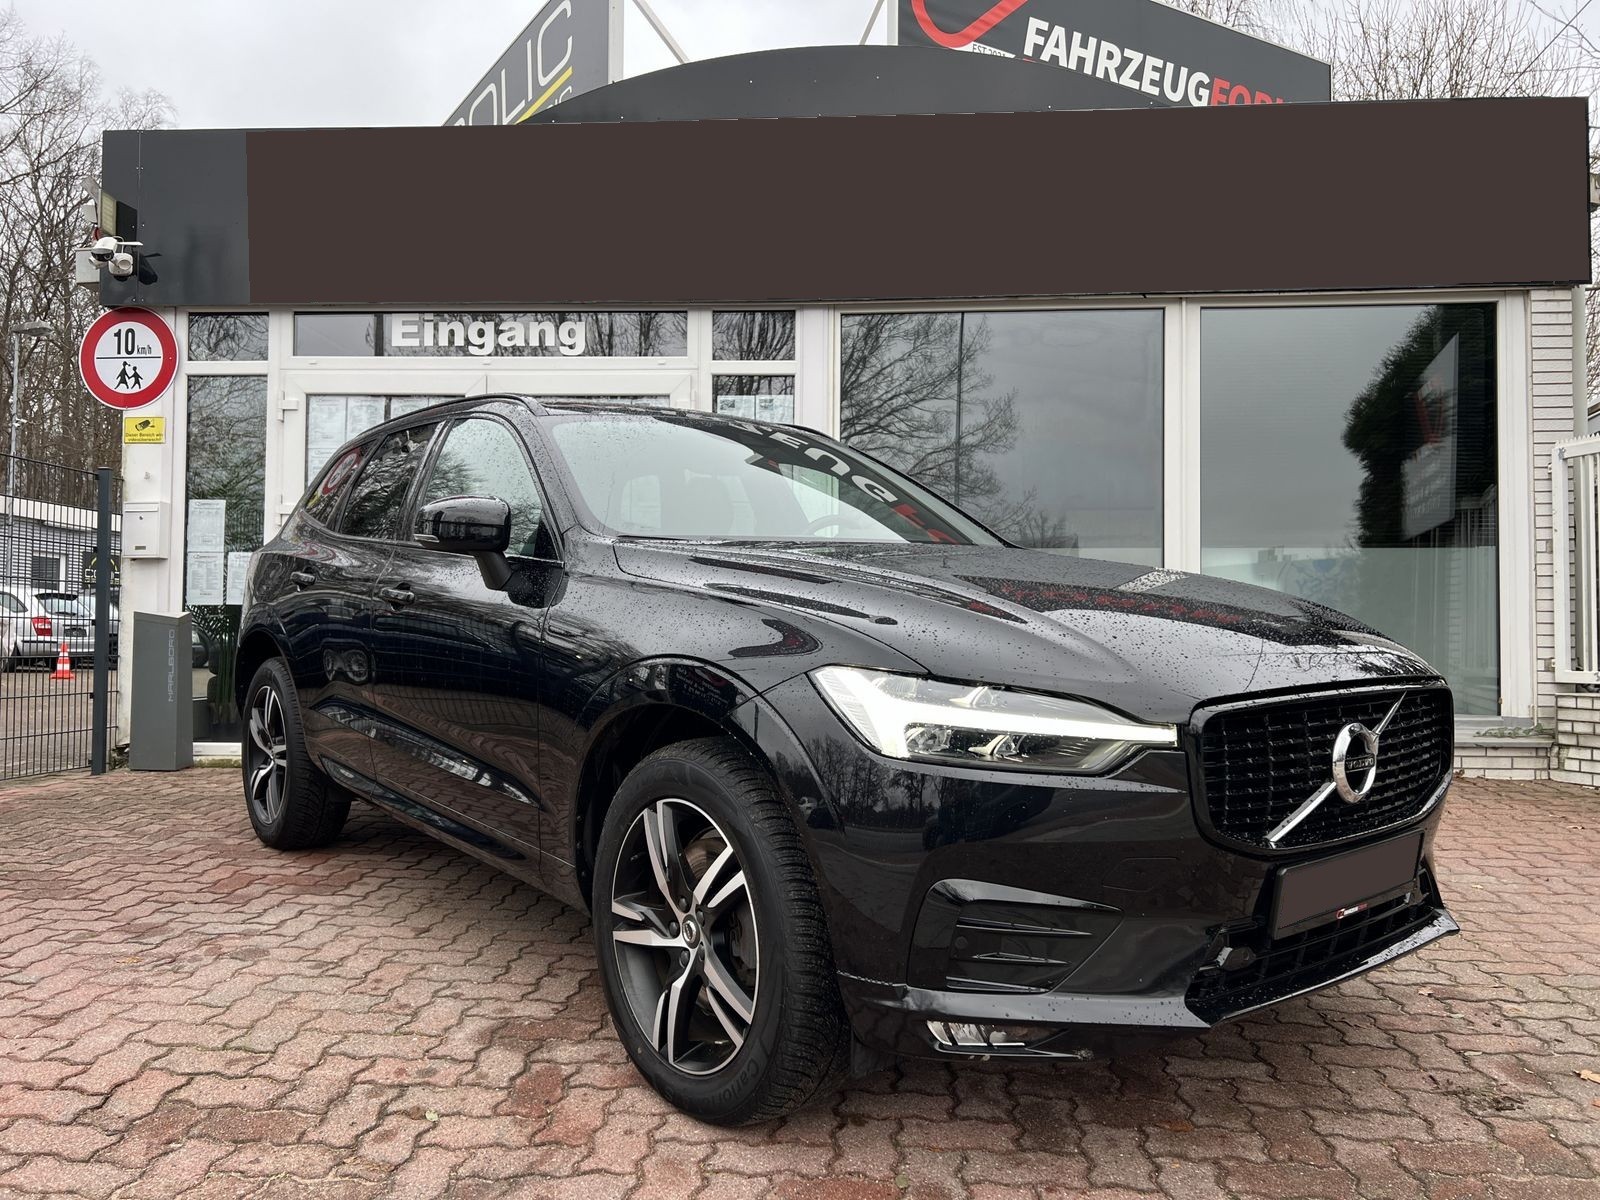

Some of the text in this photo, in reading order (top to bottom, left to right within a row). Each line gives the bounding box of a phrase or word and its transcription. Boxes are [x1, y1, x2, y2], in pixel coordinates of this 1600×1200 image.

[454, 0, 573, 126] OLIC
[1022, 16, 1285, 108] FAHRZEUGFO
[113, 328, 152, 355] 10 km/h
[391, 313, 586, 356] Eingang
[1346, 757, 1374, 769] VOLVO
